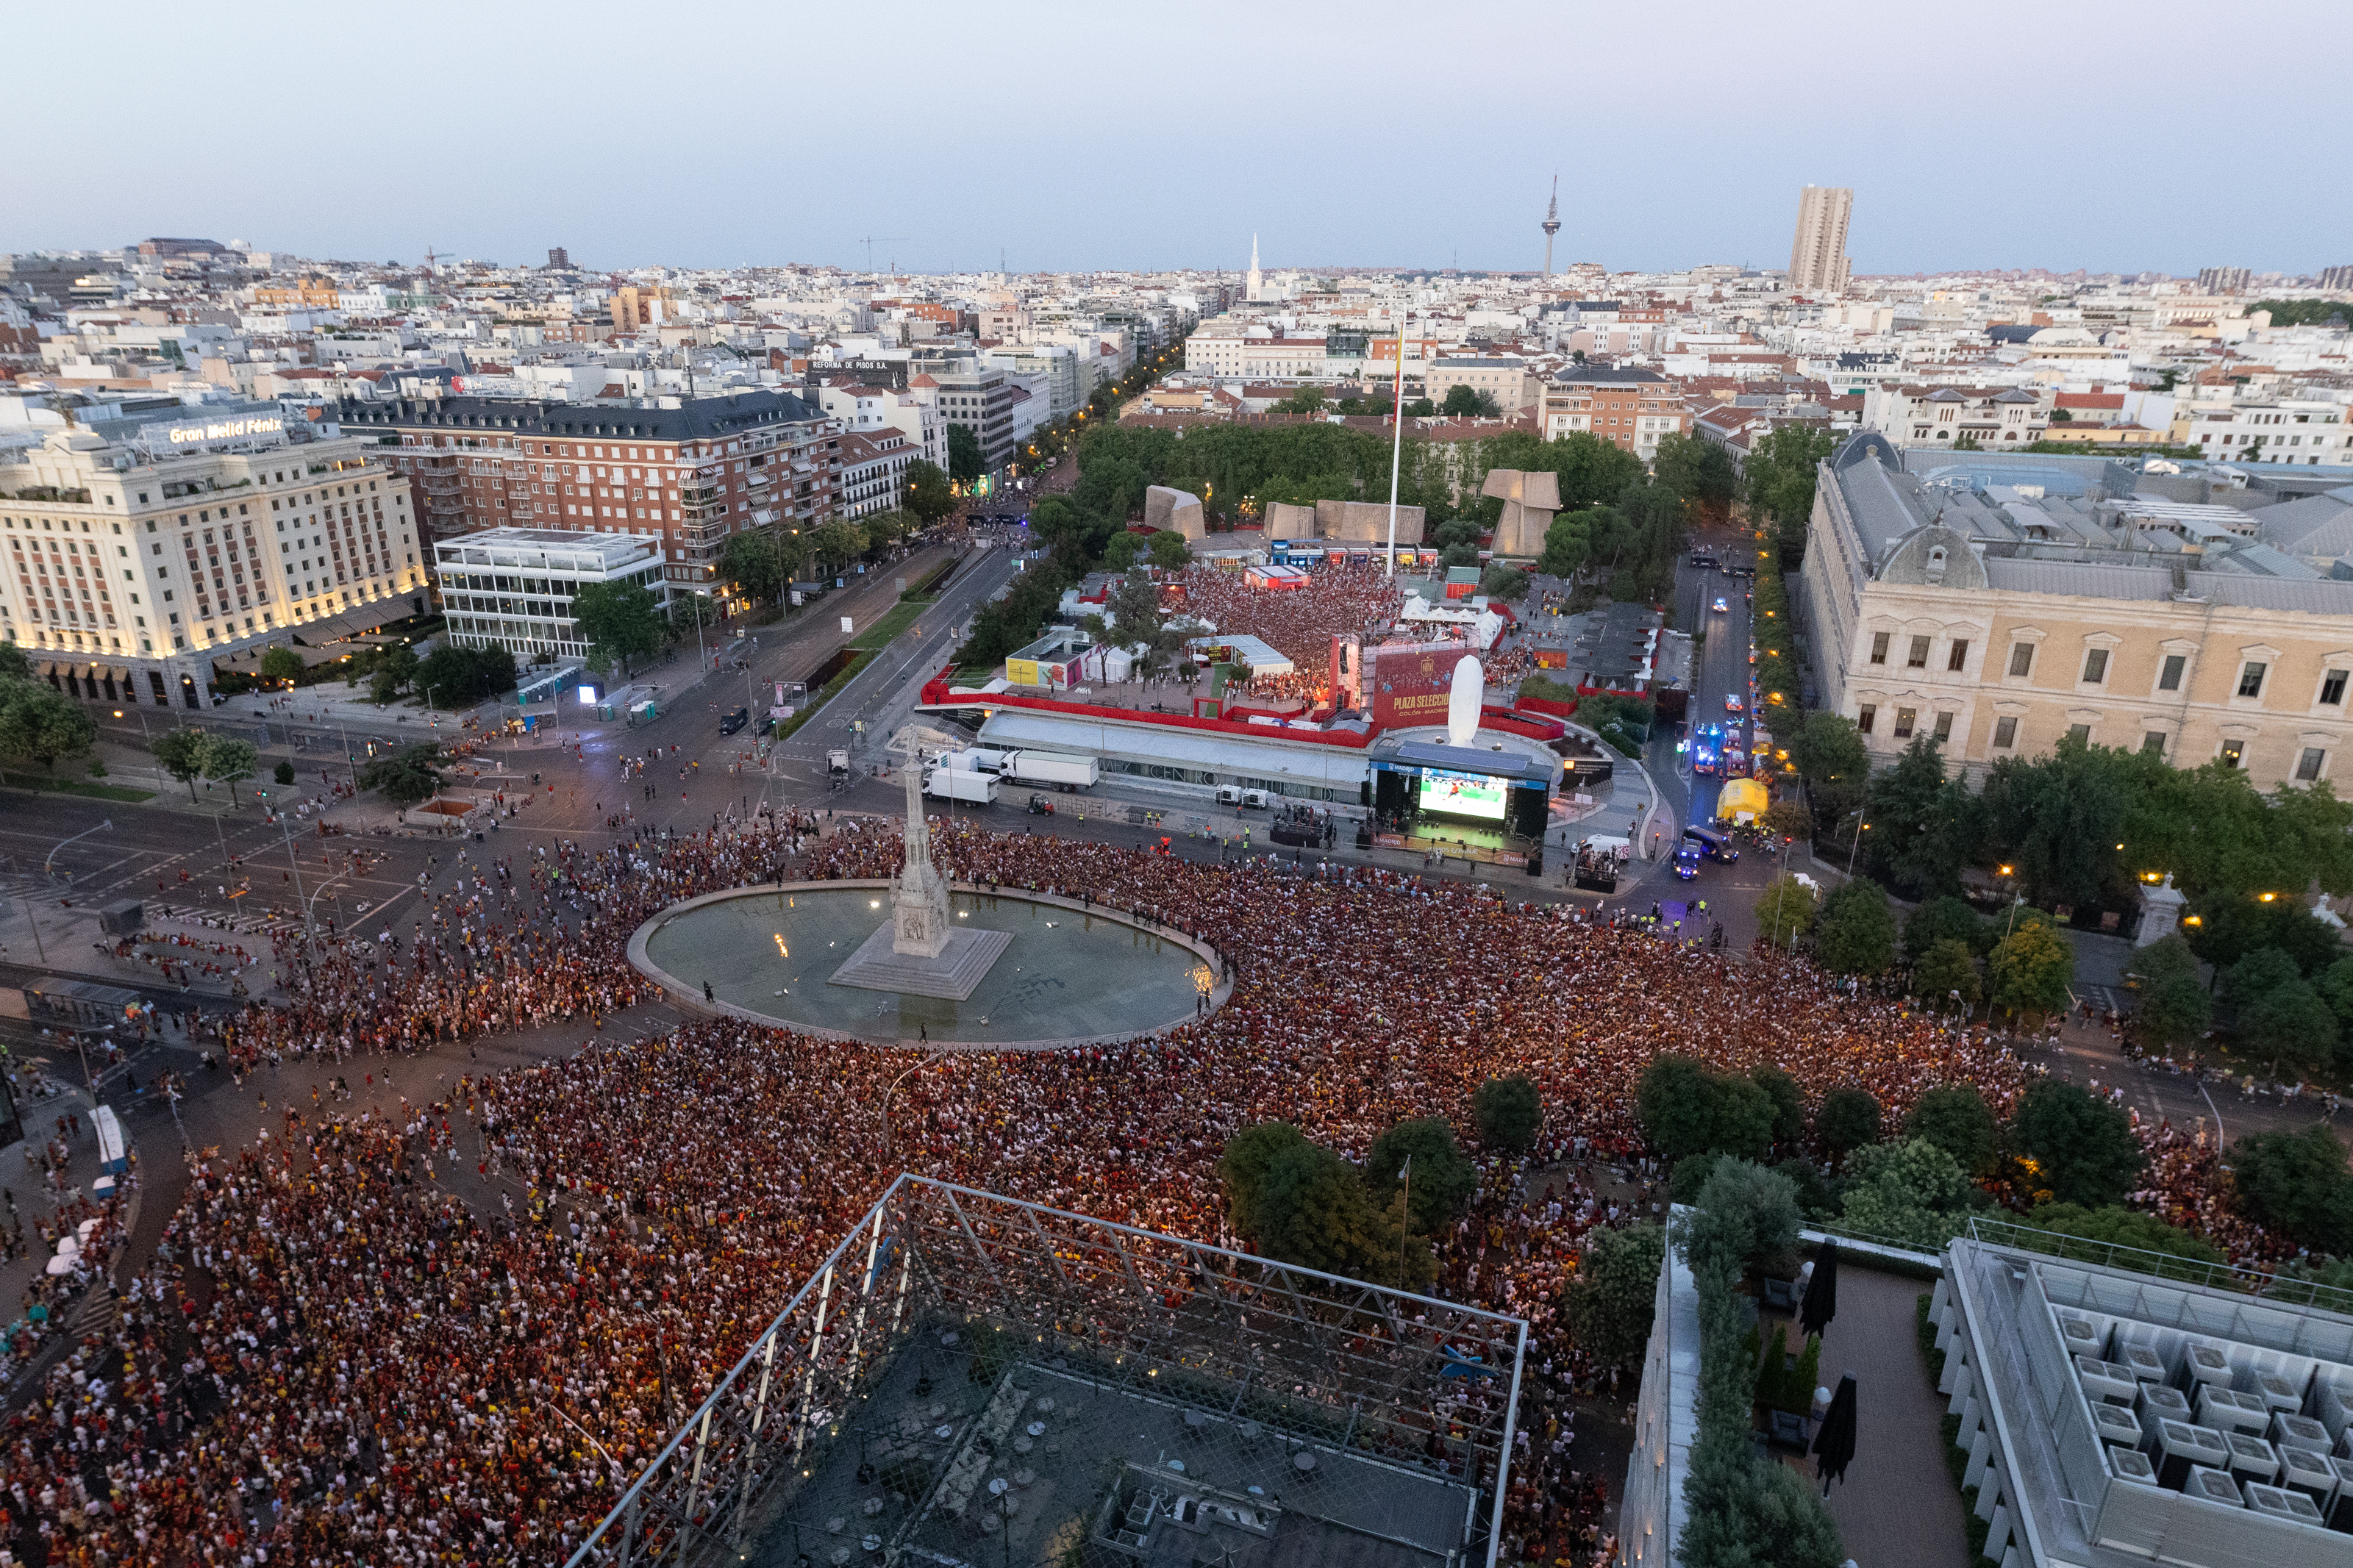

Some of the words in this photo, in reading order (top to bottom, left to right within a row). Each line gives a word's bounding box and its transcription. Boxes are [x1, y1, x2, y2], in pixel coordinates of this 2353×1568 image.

[170, 428, 204, 443] Gran
[1393, 696, 1416, 710] PLAZA
[1417, 692, 1450, 708] SELECCIÓ
[1399, 709, 1421, 717] COLÓN
[1150, 765, 1219, 786] CENTRO
[1321, 787, 1340, 803] DE
[1510, 856, 1529, 865] MADRI
